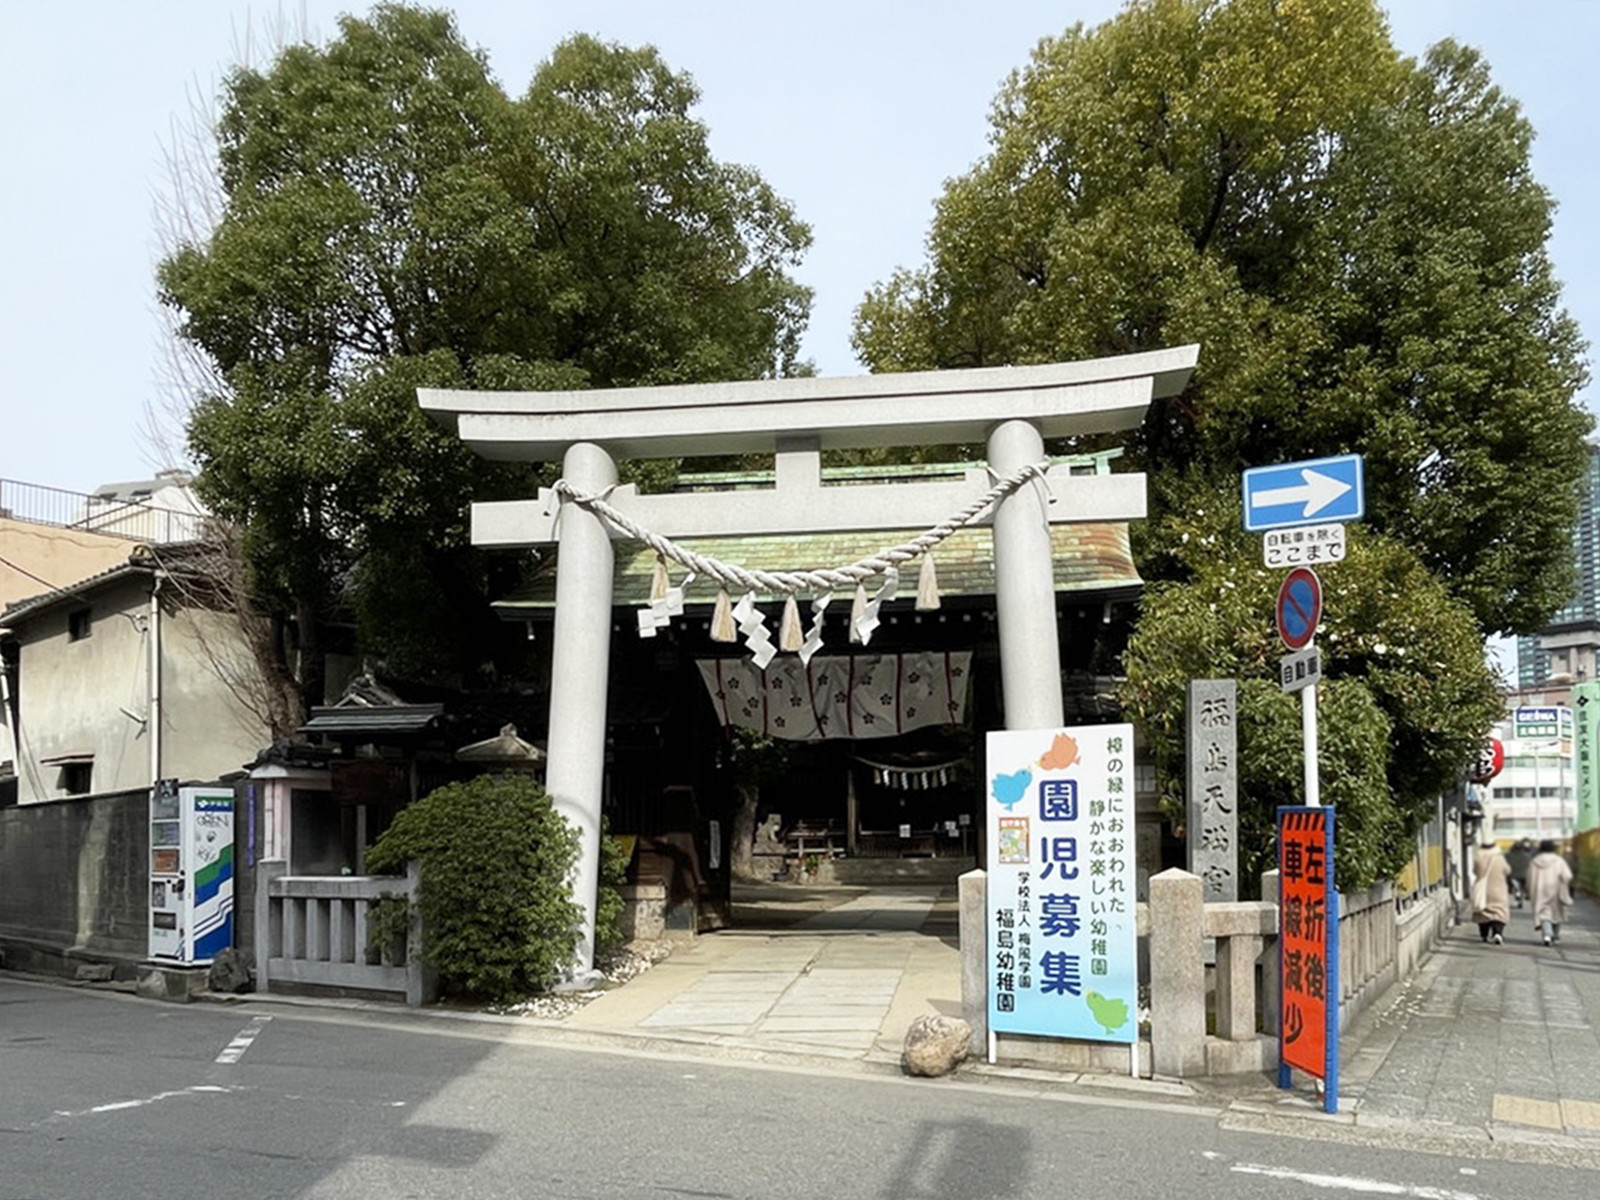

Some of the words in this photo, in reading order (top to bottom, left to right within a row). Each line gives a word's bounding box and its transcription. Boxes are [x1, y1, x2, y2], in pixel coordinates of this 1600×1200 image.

[1267, 529, 1339, 547] 自転車を除く
[1268, 542, 1342, 565] ここまで
[1284, 656, 1317, 684] 自動車
[1018, 871, 1031, 927] 学校法人
[1038, 779, 1082, 996] 園児募集
[1089, 800, 1107, 975] 静かな楽しい幼稚園
[1304, 839, 1324, 1001] 左折後
[996, 908, 1014, 1012] 福島幼稚園
[1284, 838, 1303, 1045] 車線減少
